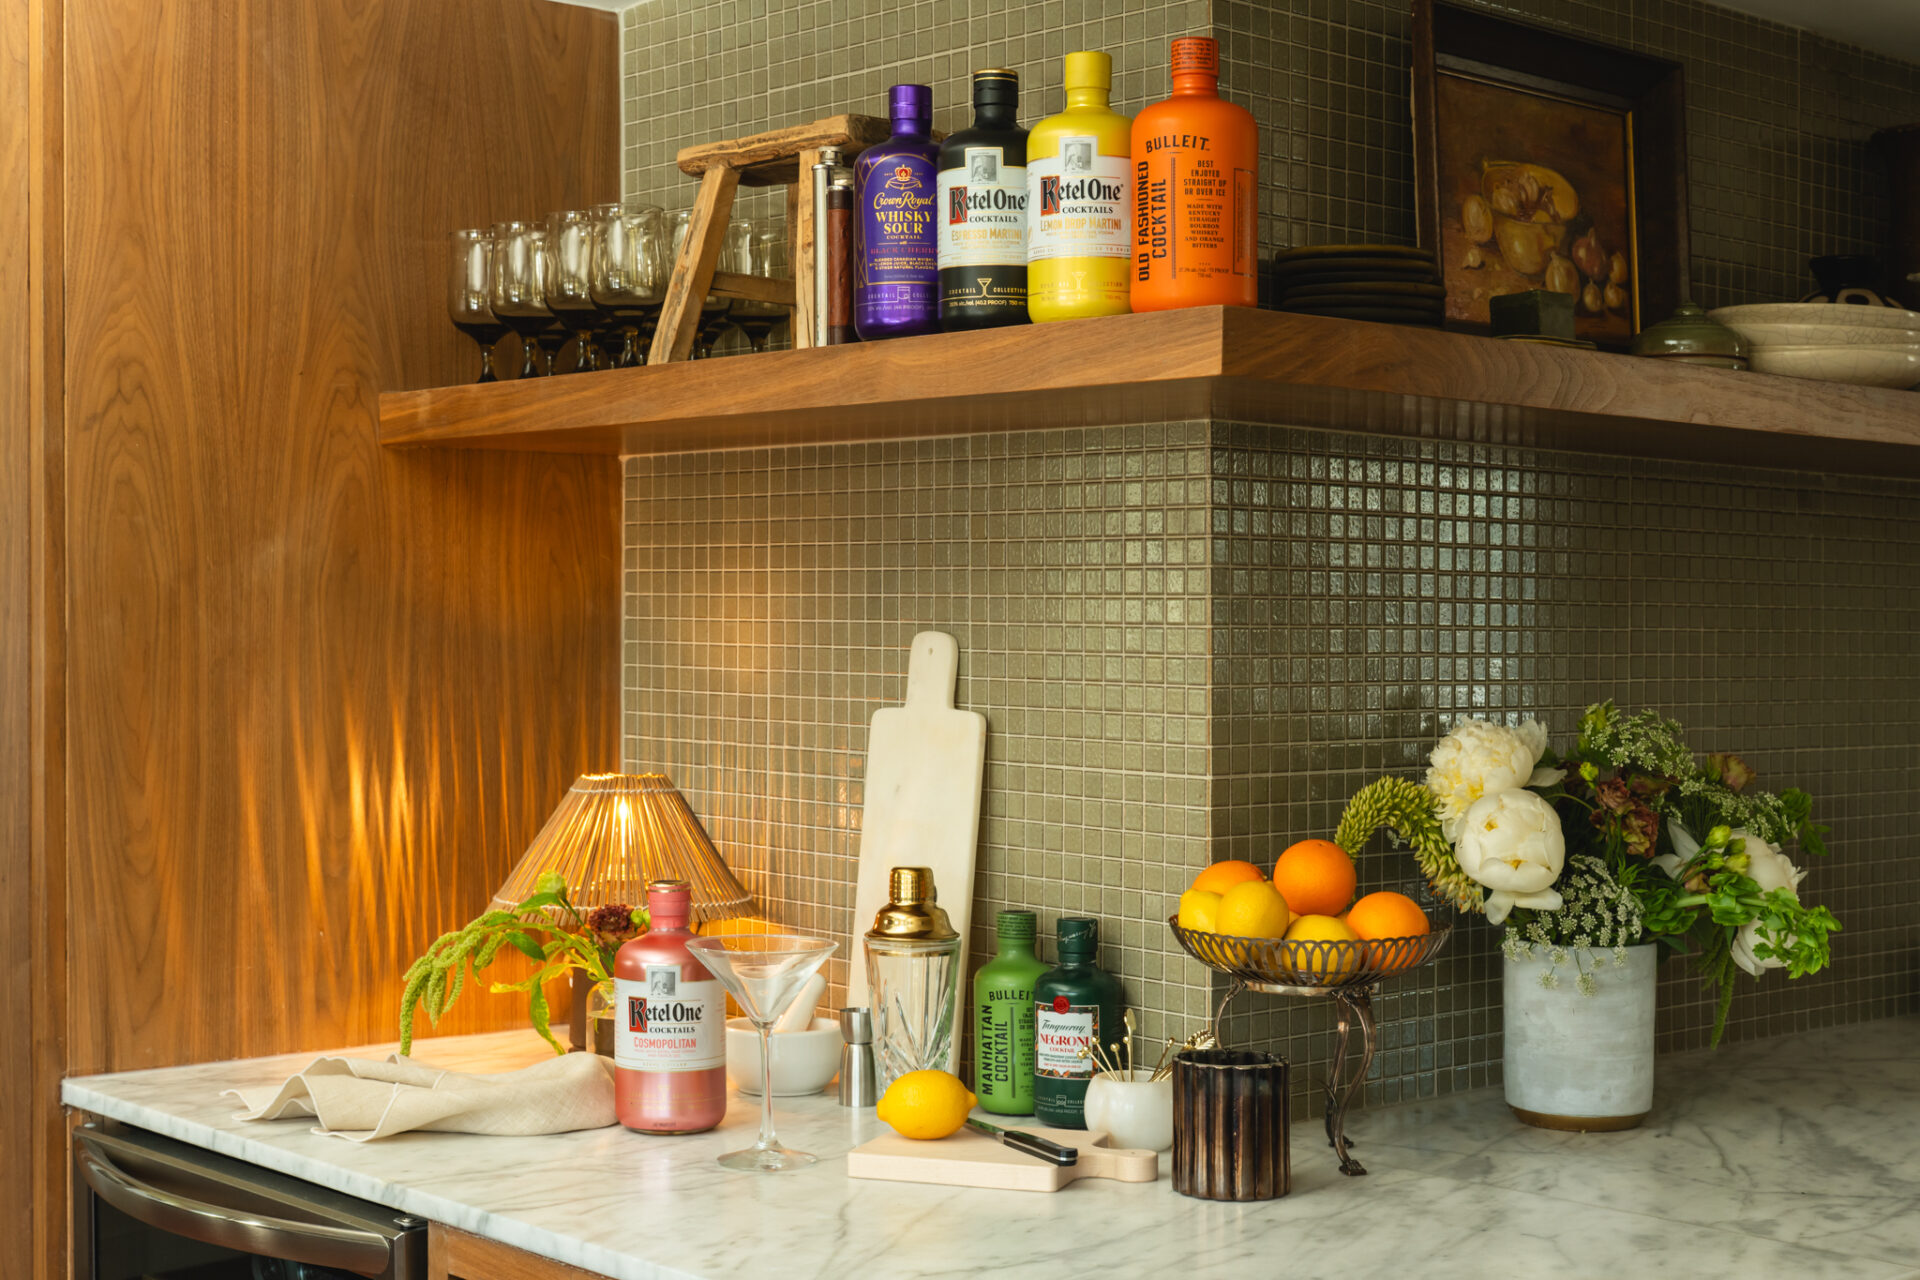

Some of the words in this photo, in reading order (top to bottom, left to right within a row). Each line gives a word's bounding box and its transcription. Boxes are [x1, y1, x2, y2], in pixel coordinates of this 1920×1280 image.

[1146, 134, 1210, 153] BULLEIT
[1197, 160, 1214, 168] BEST
[1191, 169, 1220, 178] ENJOYED
[1183, 179, 1216, 187] STRAIGHT
[873, 192, 902, 210] Crown
[896, 191, 935, 210] Royal
[1041, 178, 1086, 212] Ketel
[1087, 178, 1121, 201] One
[950, 188, 992, 221] Ketel
[993, 189, 1026, 210] One
[1062, 206, 1114, 214] COCKTAILS
[1138, 161, 1150, 246] FASHIONED
[875, 211, 931, 222] WHISKY
[1040, 218, 1063, 232] LEMON
[1088, 216, 1122, 231] MARTINI
[1151, 179, 1167, 259] COCKTAIL
[883, 222, 923, 234] SOUR
[951, 230, 988, 241] ESPRESSO
[989, 227, 1022, 240] MARTINI
[1138, 253, 1150, 282] OLD
[629, 1000, 670, 1031] Ketel
[672, 1002, 703, 1022] One
[649, 1026, 695, 1034] COCKTAILS
[1042, 1019, 1086, 1034] Tanqueray
[634, 1037, 697, 1049] COSMOPOLITAN
[1040, 1033, 1090, 1047] NEGRONI
[981, 1005, 993, 1095] MANHATTAN
[995, 1021, 1008, 1082] COCKTAIL
